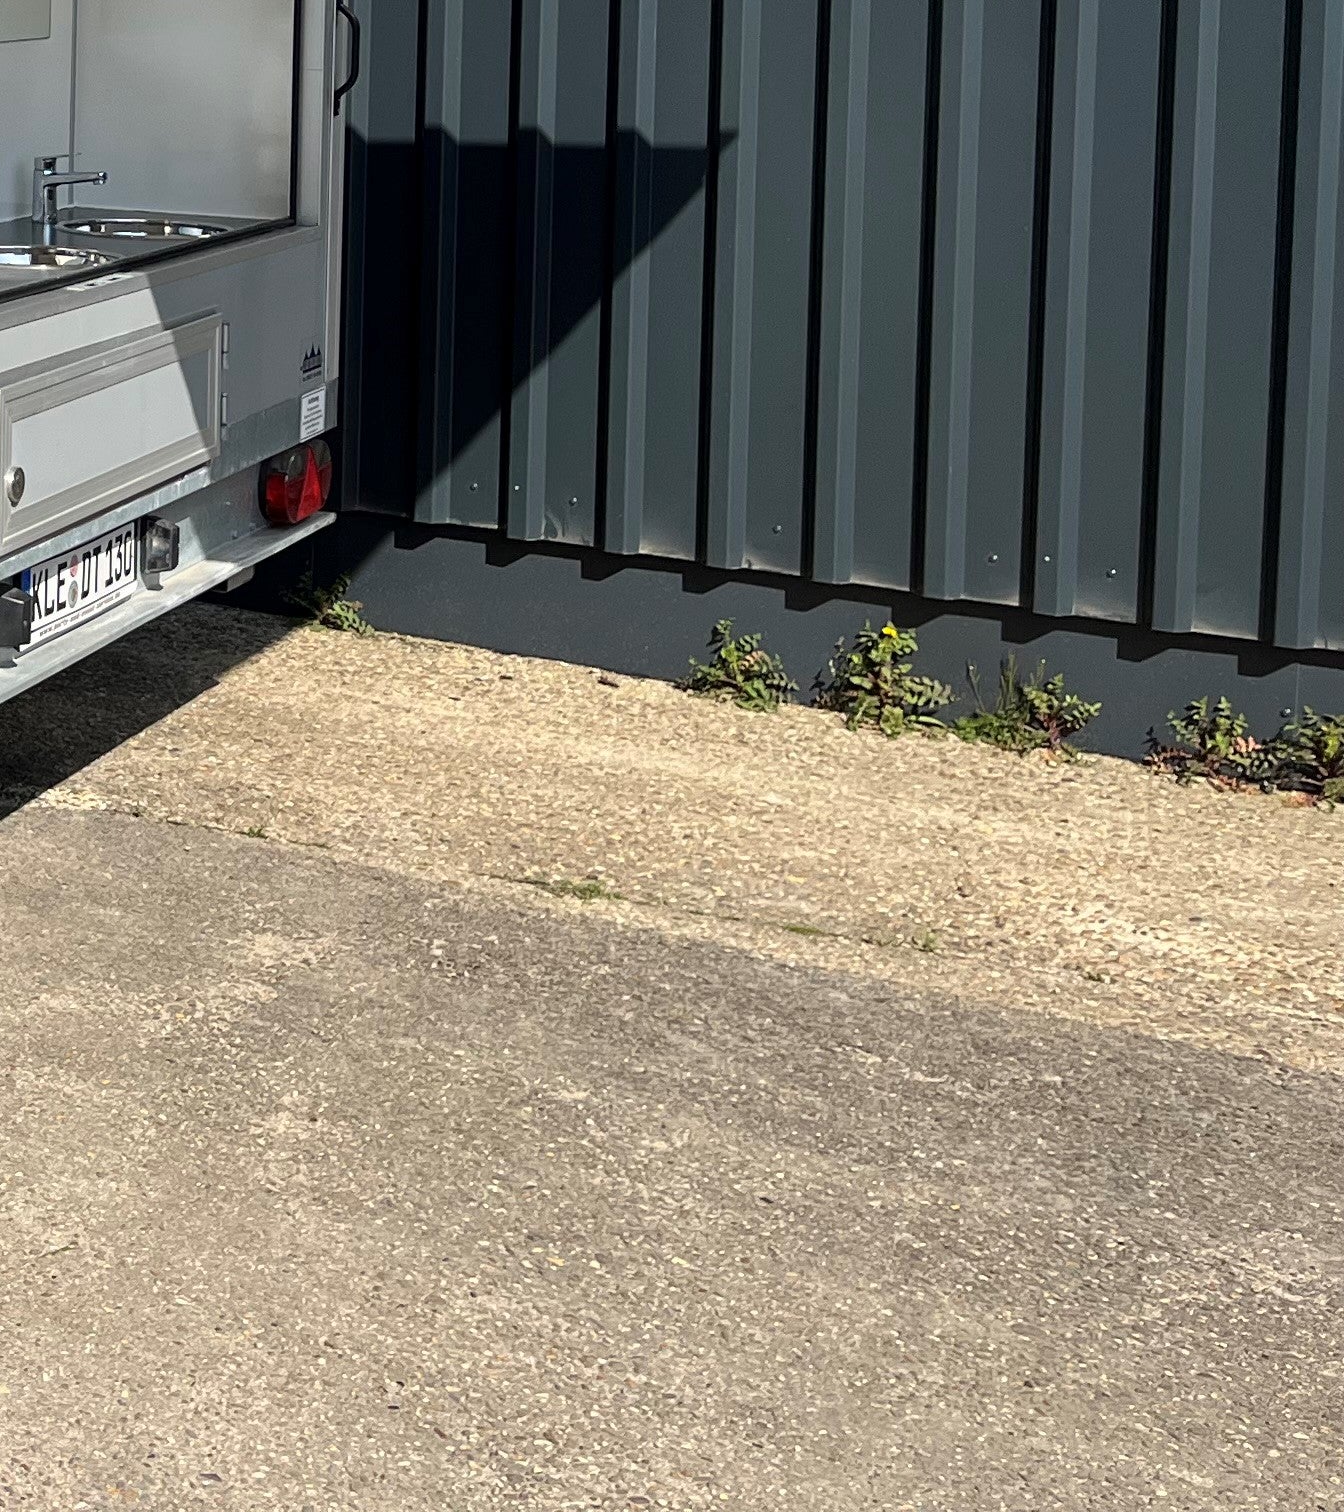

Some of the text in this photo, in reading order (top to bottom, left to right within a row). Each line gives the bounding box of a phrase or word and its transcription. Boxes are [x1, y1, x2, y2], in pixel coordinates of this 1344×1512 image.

[31, 561, 68, 622] KLE
[81, 544, 102, 600] DT
[105, 530, 132, 587] 130
